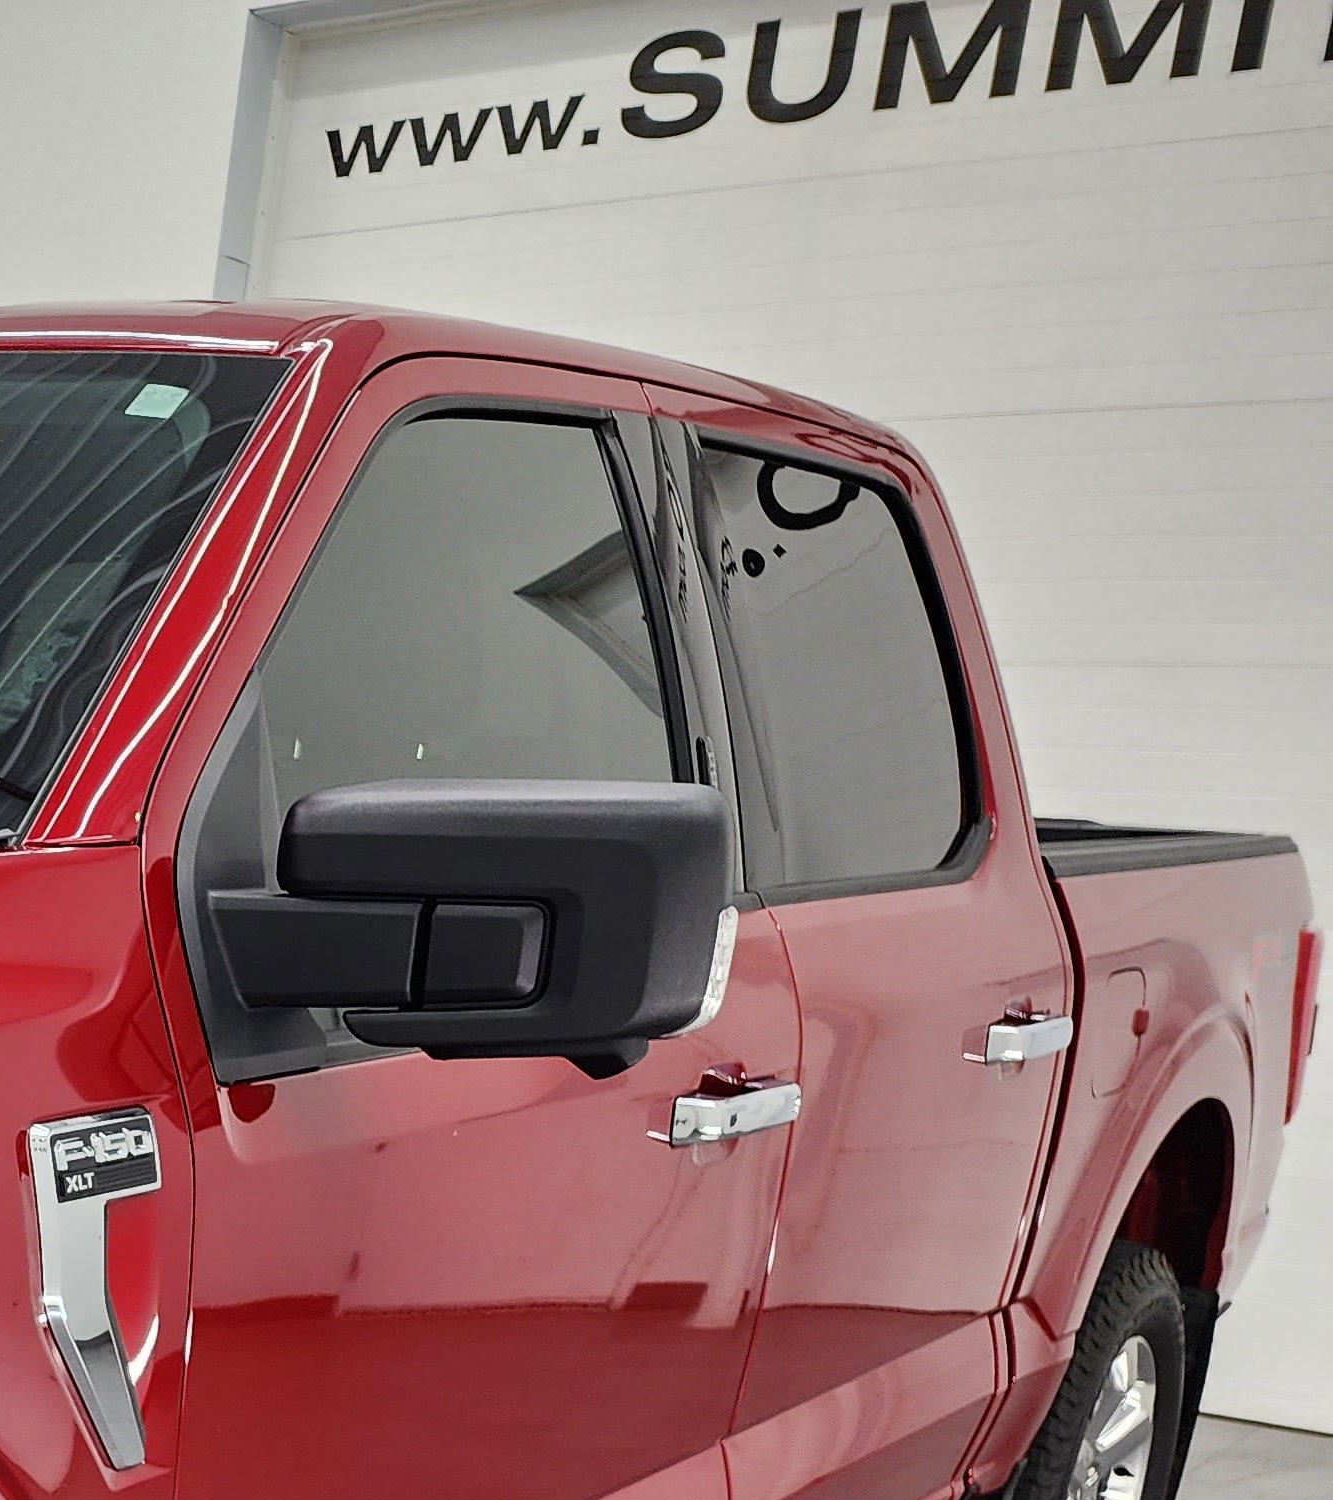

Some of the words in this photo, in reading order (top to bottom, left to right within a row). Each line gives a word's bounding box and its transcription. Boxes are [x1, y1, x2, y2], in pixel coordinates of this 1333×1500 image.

[325, 0, 1333, 178] www.SUMMI
[54, 1127, 154, 1171] F-150
[65, 1172, 94, 1194] XLT
